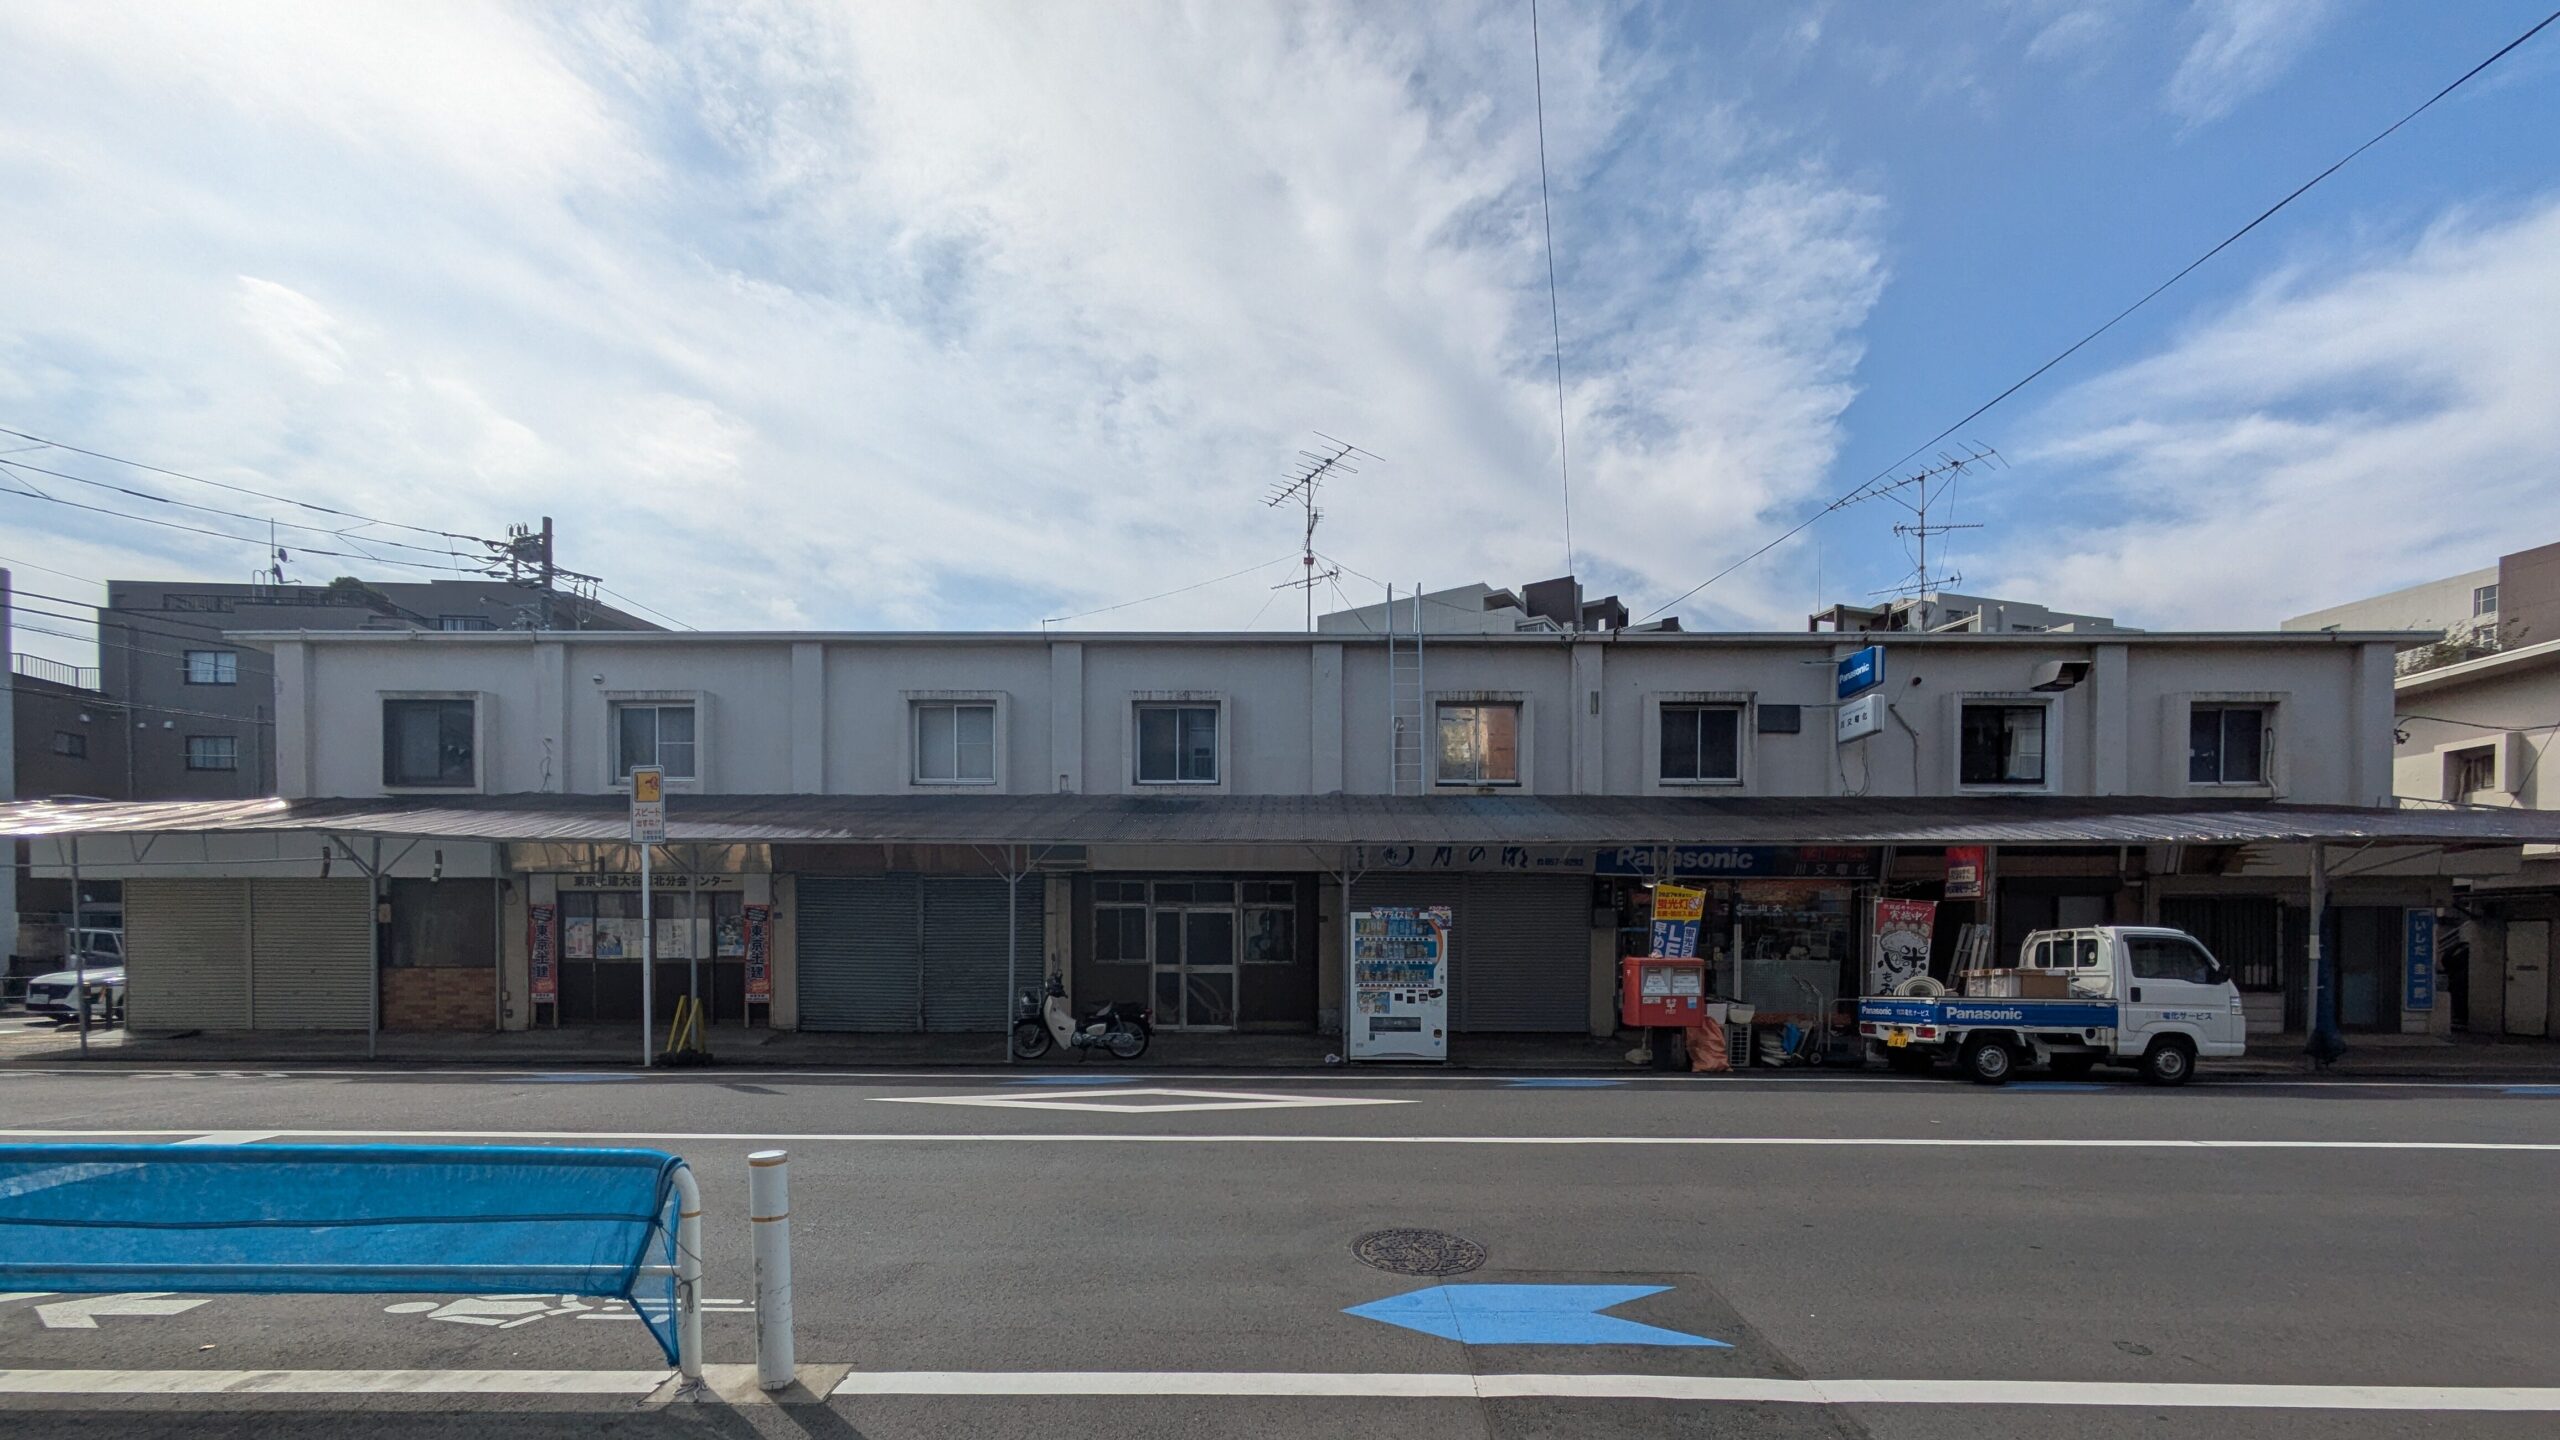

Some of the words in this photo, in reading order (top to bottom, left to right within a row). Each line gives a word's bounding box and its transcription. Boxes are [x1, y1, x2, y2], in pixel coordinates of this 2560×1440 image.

[1839, 662, 1870, 684] Panasonic
[1616, 846, 1753, 870] Panasonic
[1656, 899, 1688, 910] 蛍光灯
[535, 924, 550, 979] 東京土建
[750, 924, 764, 979] 東京土建
[1861, 1005, 1893, 1016] Panasonic
[1946, 1006, 2023, 1020] Panasonic
